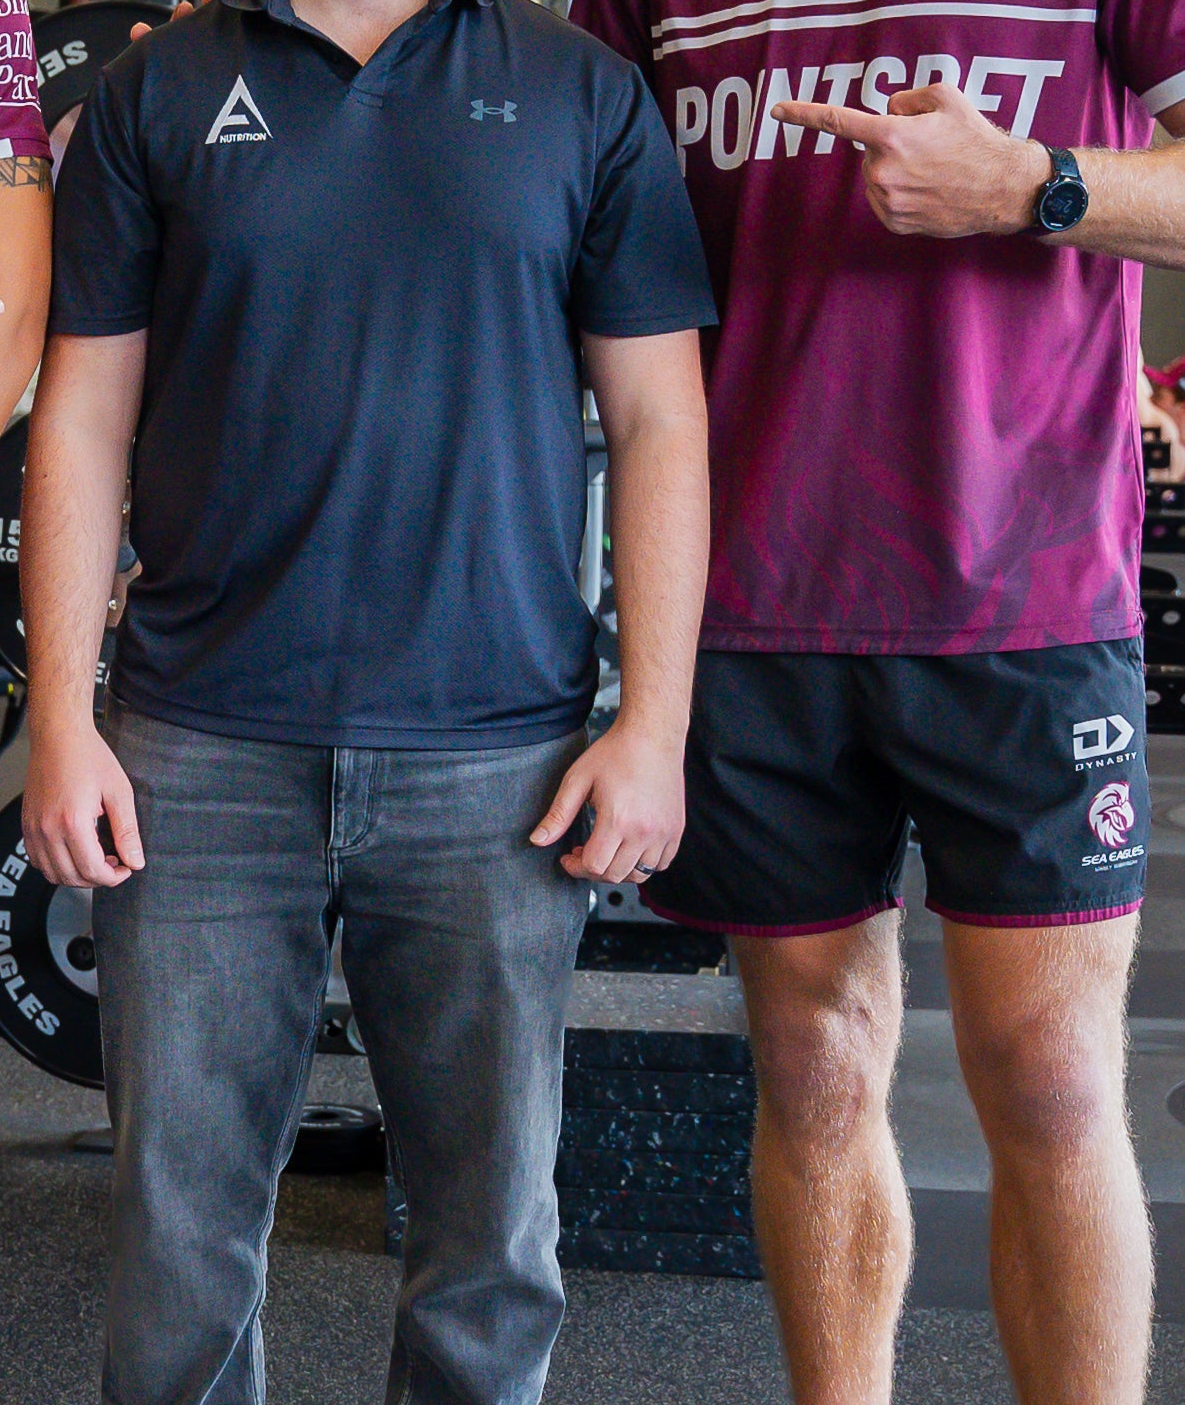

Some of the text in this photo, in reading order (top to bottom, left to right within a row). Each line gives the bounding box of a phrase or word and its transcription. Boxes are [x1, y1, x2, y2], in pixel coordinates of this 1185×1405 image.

[219, 132, 267, 144] NUTRITION
[1074, 752, 1138, 772] DYNASTY
[1081, 854, 1108, 867] SEA
